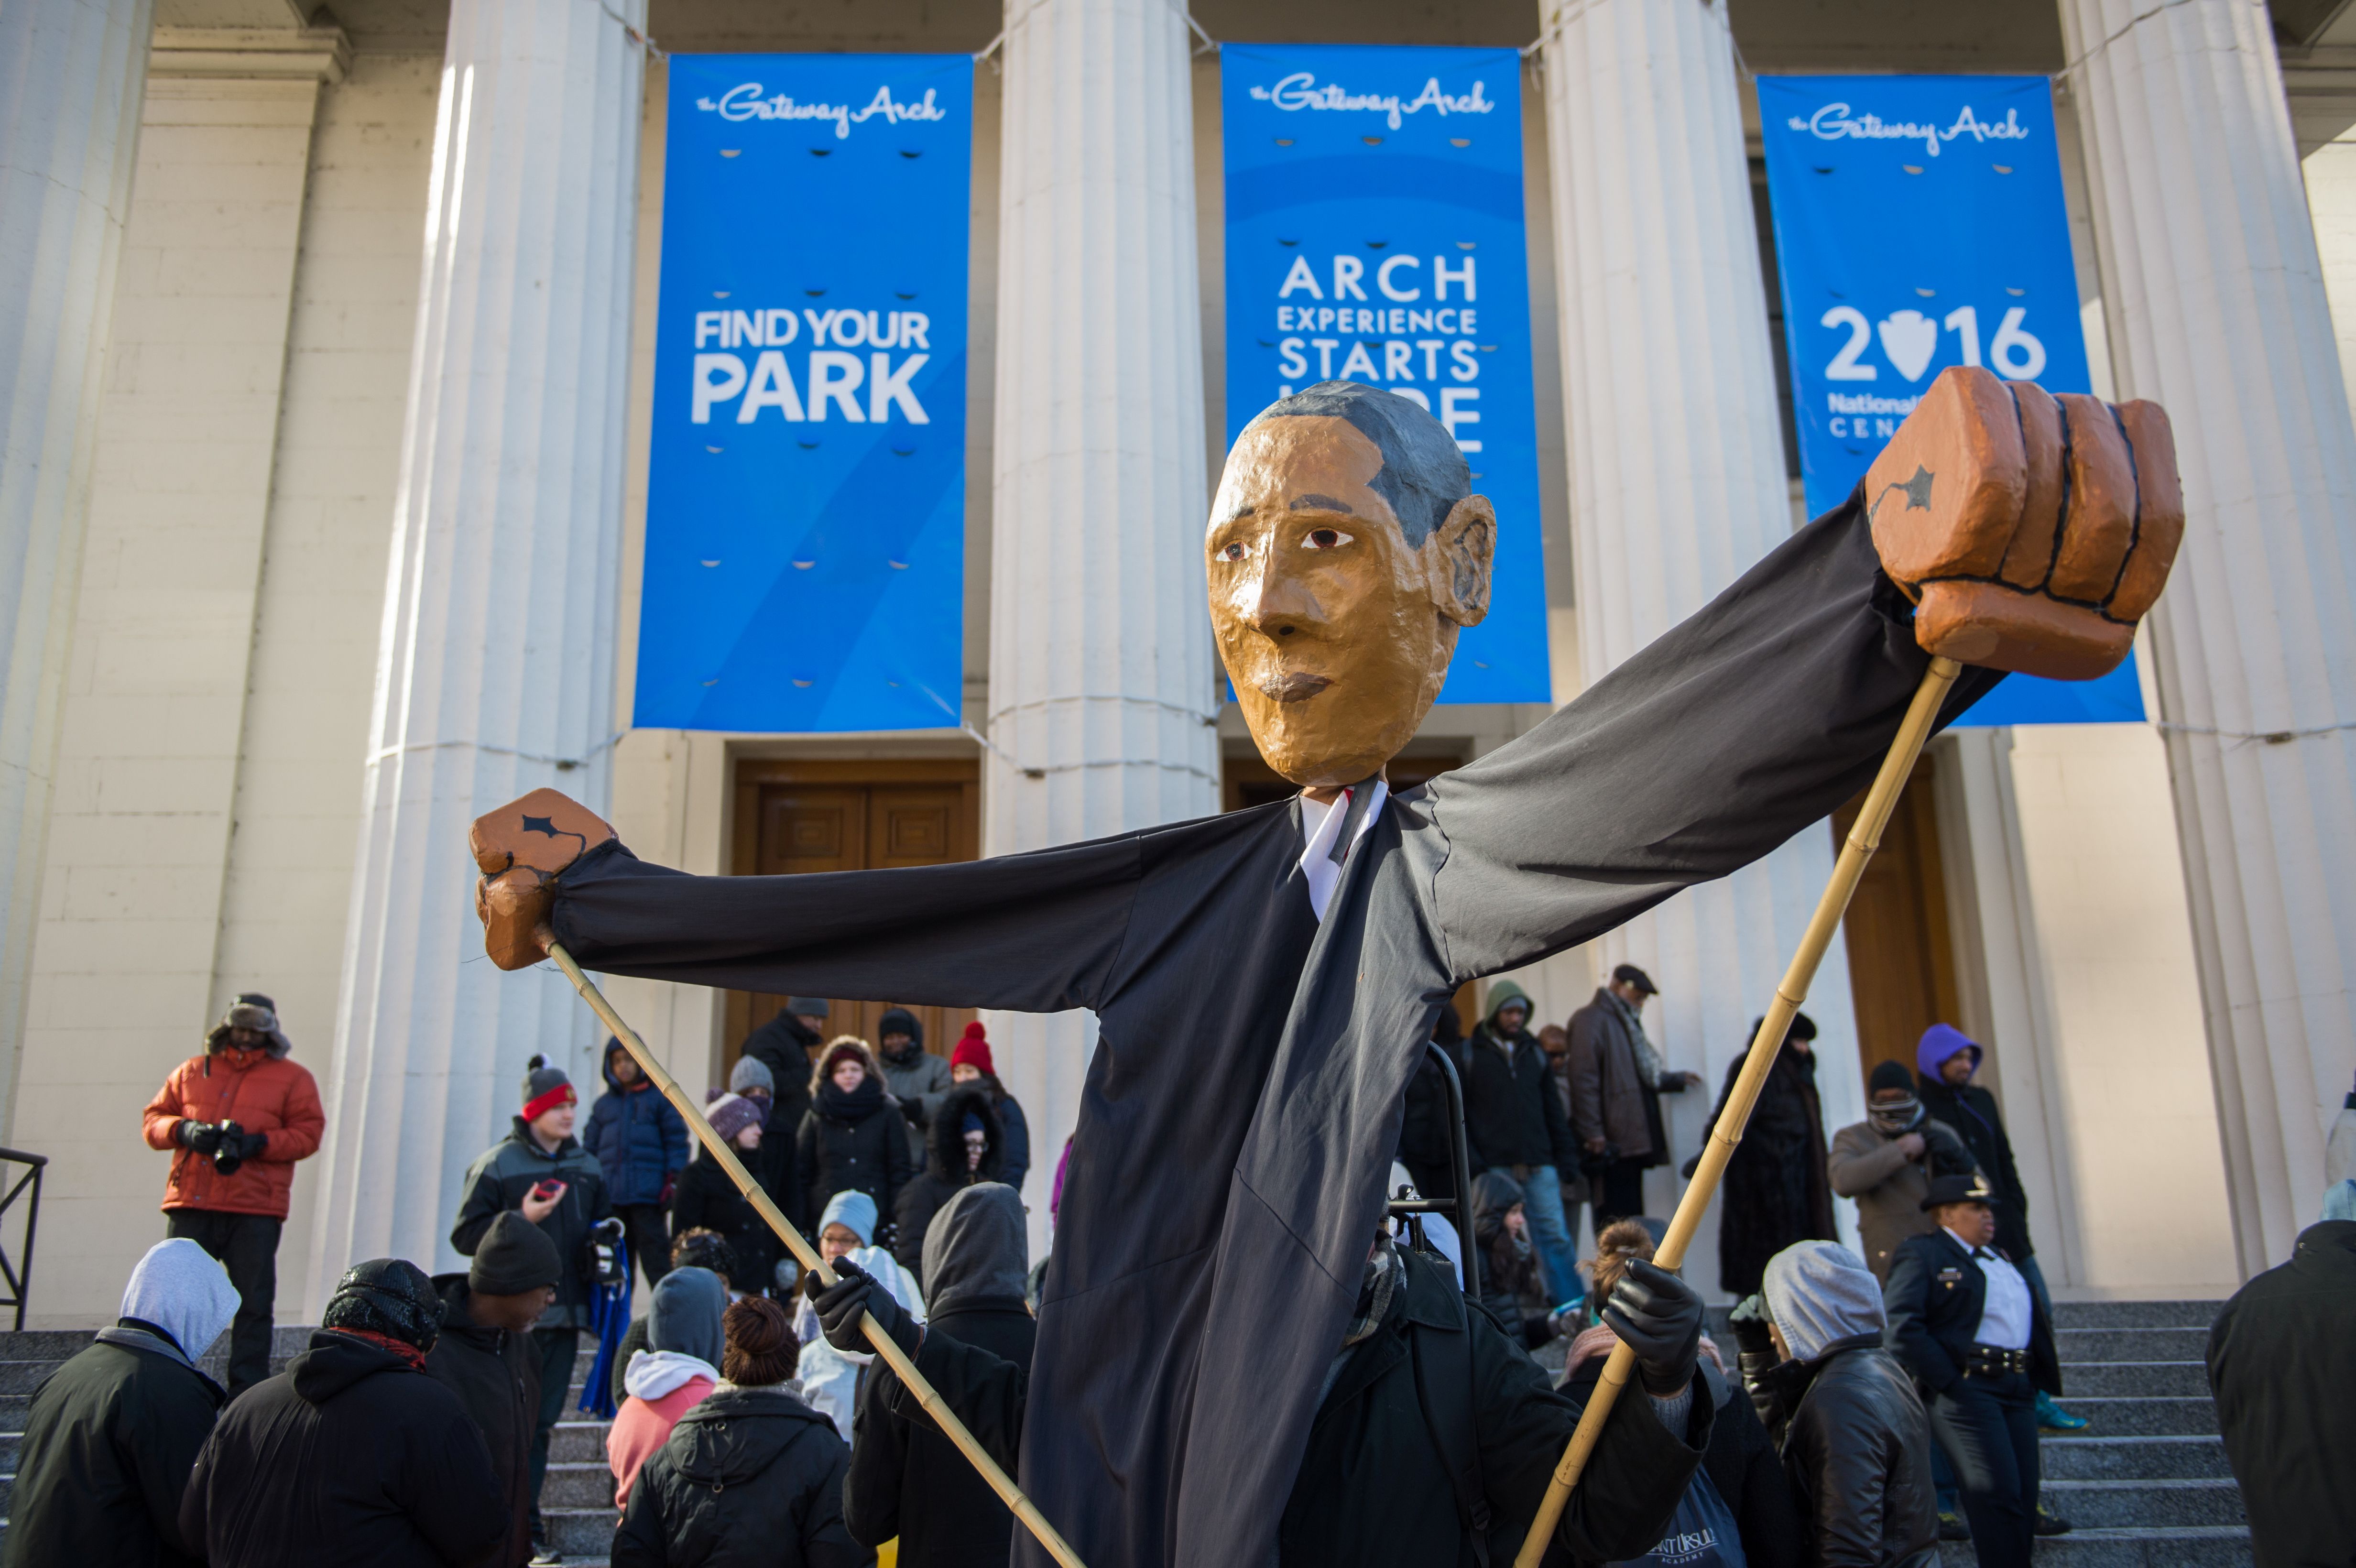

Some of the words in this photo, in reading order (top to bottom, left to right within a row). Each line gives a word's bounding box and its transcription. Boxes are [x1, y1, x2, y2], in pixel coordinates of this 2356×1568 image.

[718, 83, 850, 140] Gateway
[850, 85, 946, 125] Arch
[1271, 72, 1402, 131] Gateway
[1400, 77, 1495, 117] Arch
[1809, 102, 1940, 157] Gateway
[1939, 105, 2029, 142] Arch
[1278, 254, 1476, 302] ARCH
[695, 308, 799, 348] FIND
[803, 308, 930, 349] YOUR
[1277, 305, 1477, 335] EXPERIENCE
[1278, 338, 1480, 382] STARTS
[691, 350, 930, 424] PARK
[1827, 392, 1919, 416] National
[1661, 1551, 1703, 1564] ACADEMY
